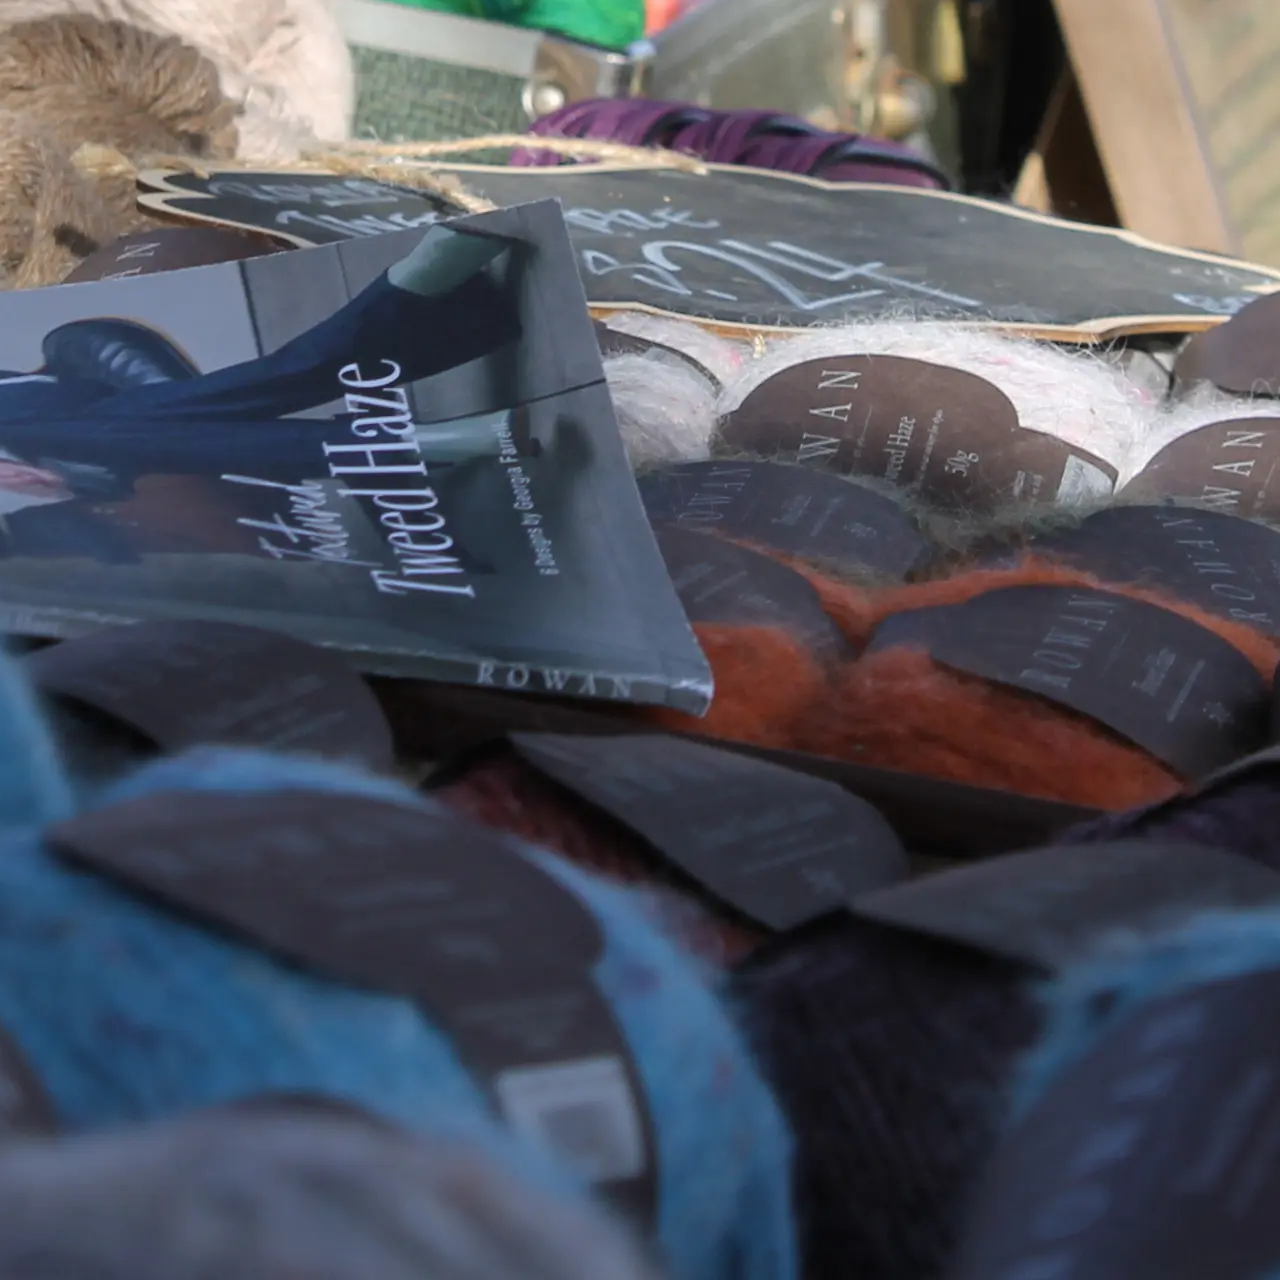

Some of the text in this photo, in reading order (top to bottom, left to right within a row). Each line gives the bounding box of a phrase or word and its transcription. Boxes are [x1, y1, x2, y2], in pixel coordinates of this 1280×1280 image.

[583, 239, 982, 310] $24
[491, 422, 518, 464] Farrell
[797, 370, 862, 462] WAN
[887, 415, 916, 448] Haze
[322, 358, 476, 596] Tweed Haze
[507, 466, 534, 510] Georgia
[944, 450, 979, 477] 50g
[1200, 431, 1265, 509] WAN
[677, 466, 752, 521] OWAN
[1162, 518, 1272, 624] ROWAN
[476, 661, 632, 699] ROWAN
